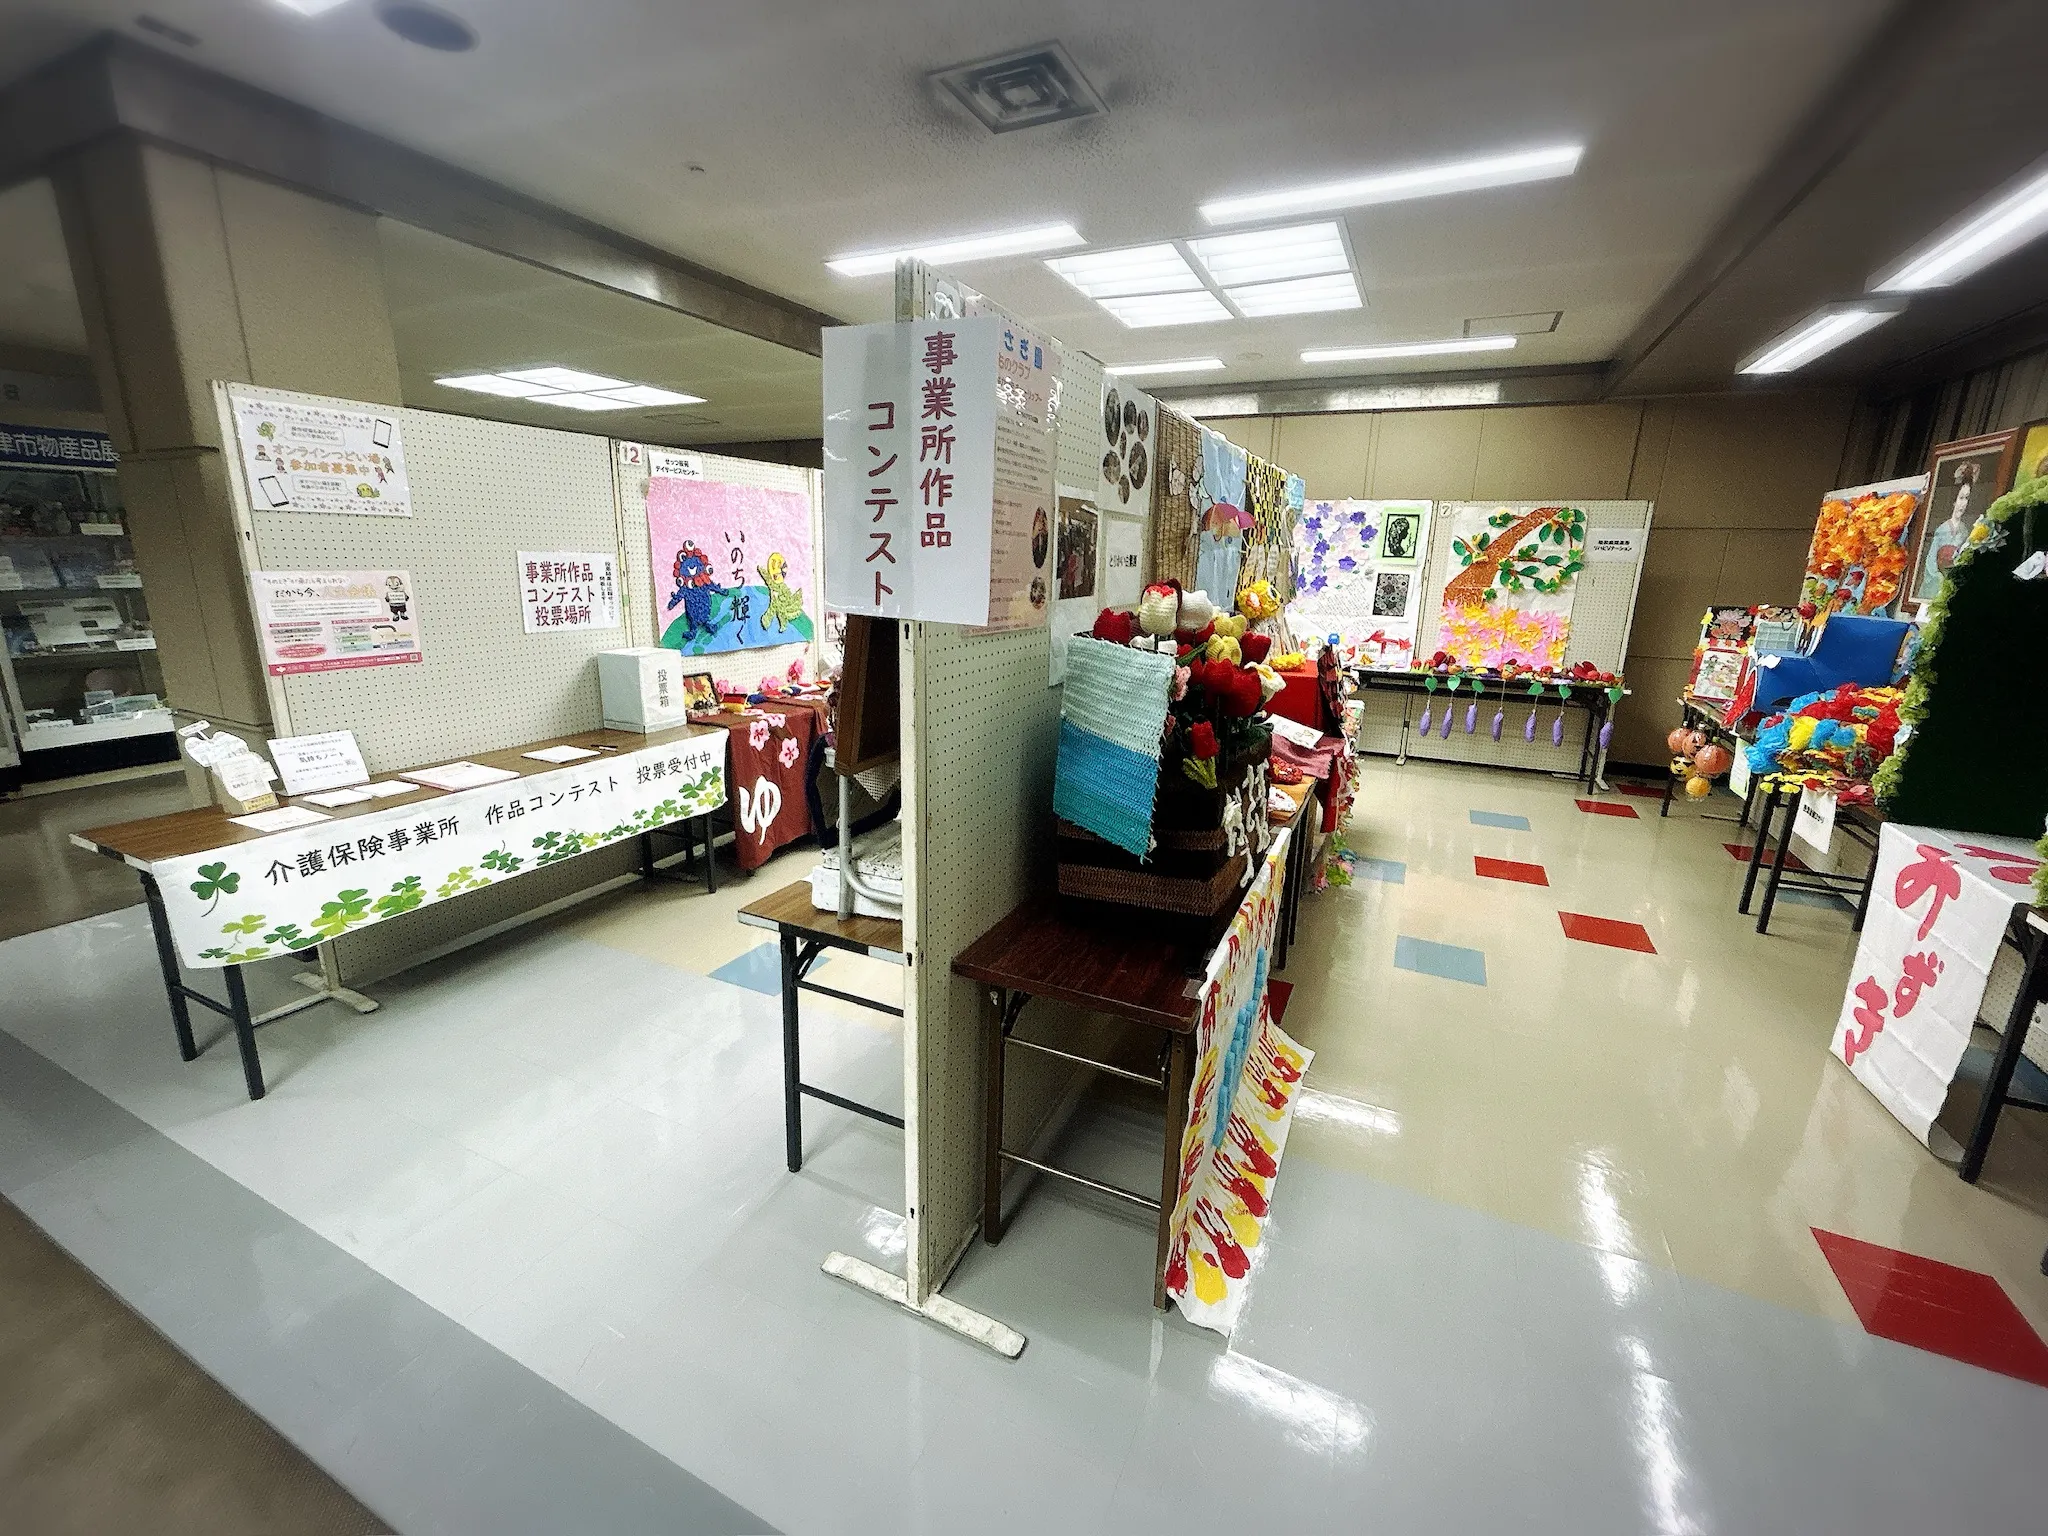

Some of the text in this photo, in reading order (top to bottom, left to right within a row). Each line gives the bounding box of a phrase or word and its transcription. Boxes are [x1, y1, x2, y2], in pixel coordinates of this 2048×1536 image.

[0, 431, 121, 462] 津市物産品展
[920, 331, 958, 548] 事業所作品
[289, 458, 370, 476] 参加者募集中
[621, 445, 640, 463] 12
[864, 401, 899, 606] コンテスト
[1442, 505, 1450, 515] 7
[526, 561, 594, 584] 事業所作品
[527, 586, 595, 604] コンテスト
[724, 530, 751, 645] いのち輝く
[535, 605, 591, 627] 投票場所
[656, 669, 670, 708] 投票箱
[299, 752, 344, 763] 気持ちノート
[264, 750, 712, 886] 介護保険事業所 作品コンテスト 投票受付中
[739, 776, 782, 845] ゆ
